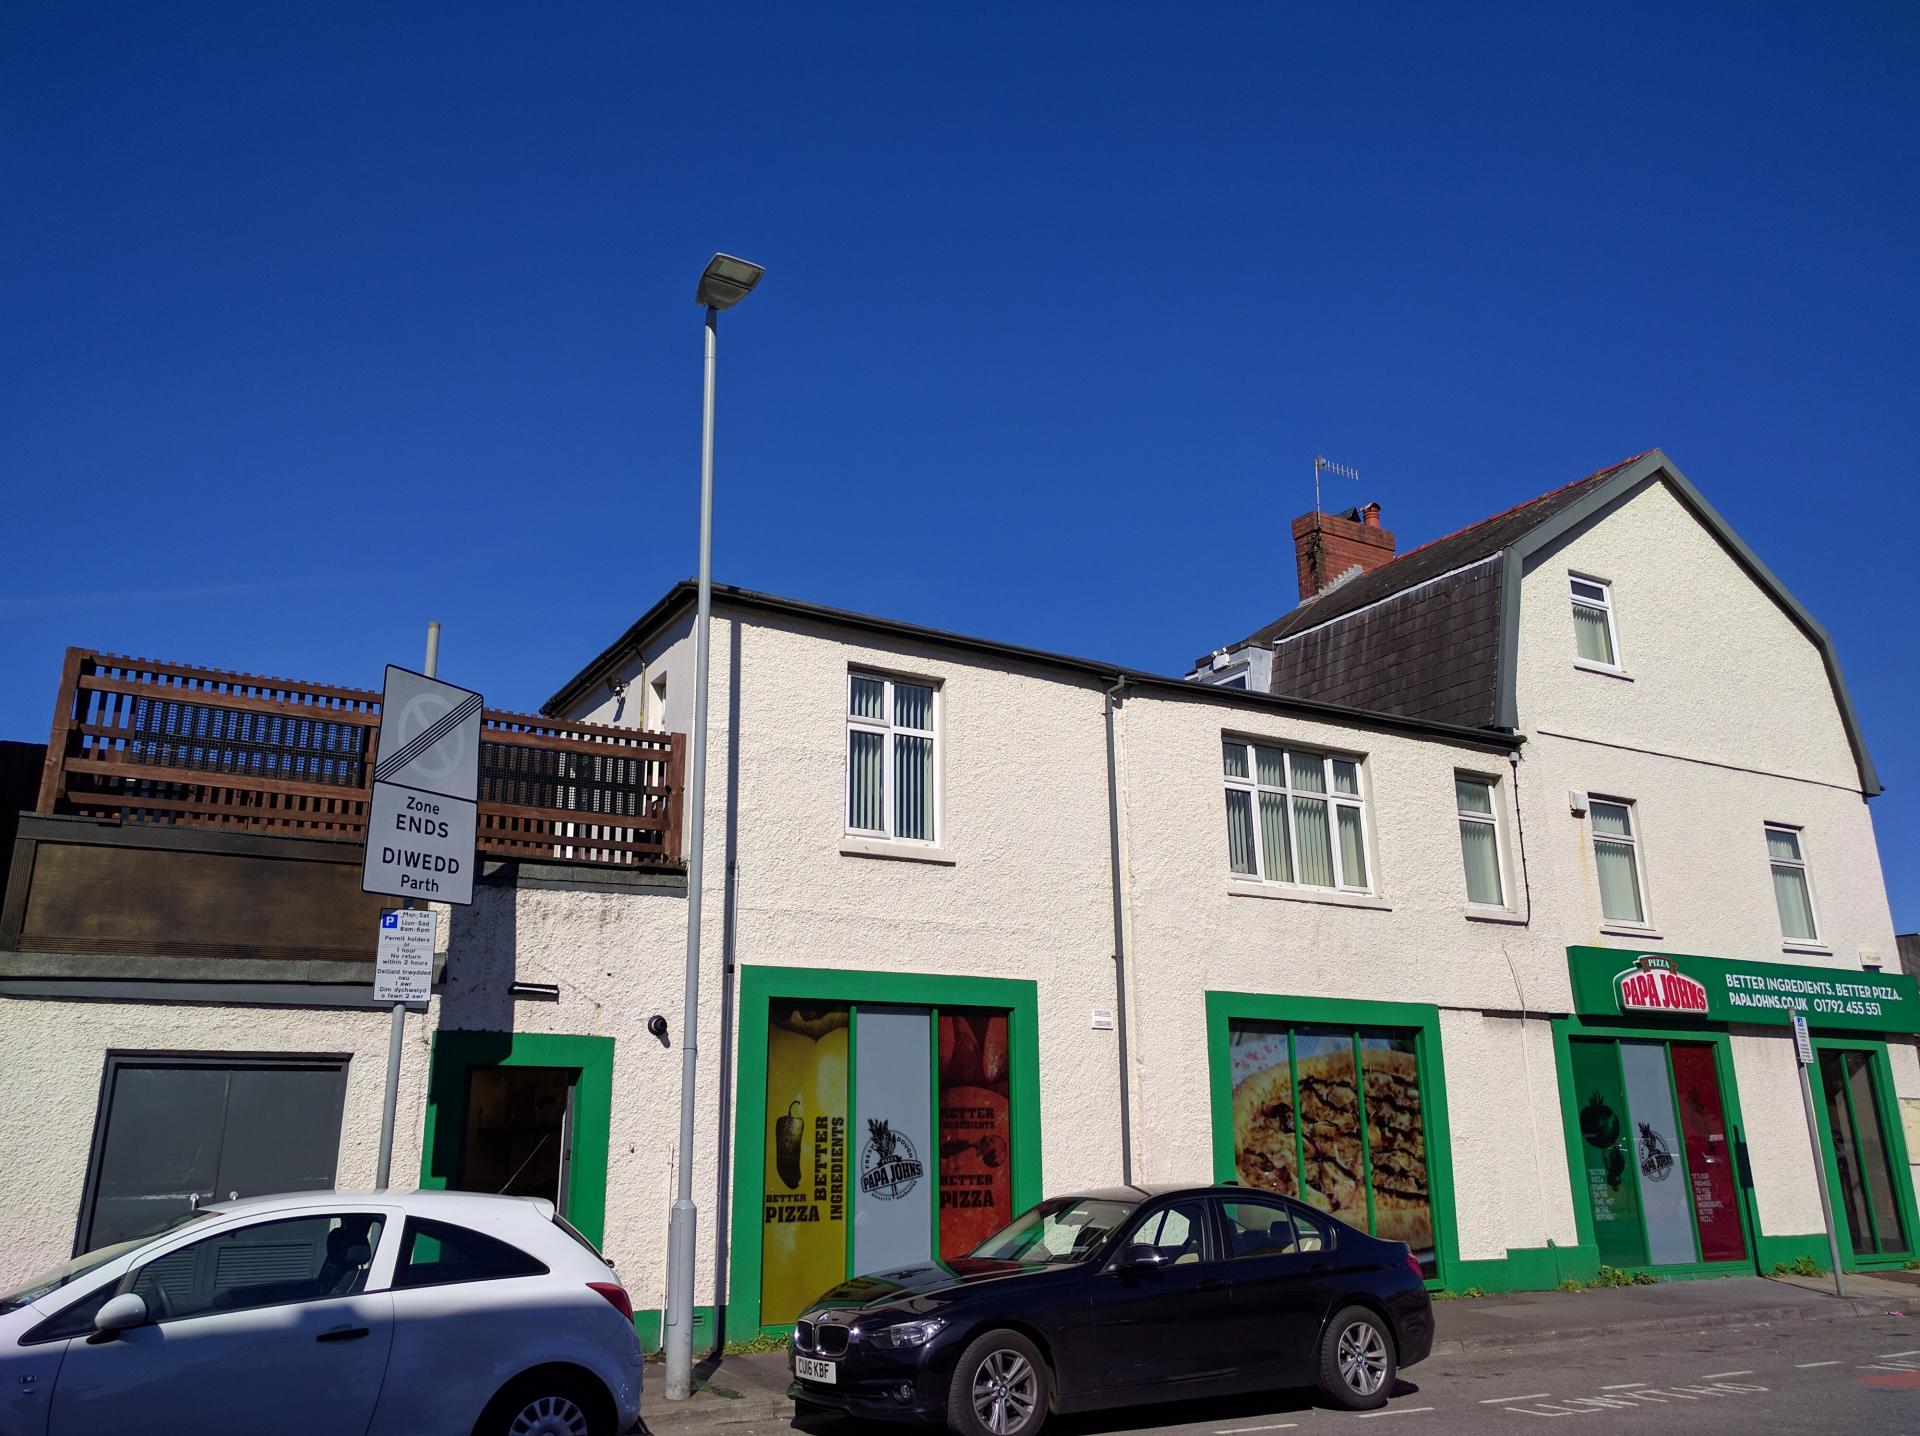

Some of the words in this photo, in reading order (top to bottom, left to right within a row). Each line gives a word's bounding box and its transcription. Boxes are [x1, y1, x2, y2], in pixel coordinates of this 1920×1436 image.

[406, 796, 440, 815] Zone
[396, 813, 449, 839] ENDS
[382, 847, 460, 875] DIWEDD
[400, 874, 439, 893] Parth
[1647, 958, 1670, 969] PIZZA
[1622, 973, 1662, 1007] PAPA
[1660, 974, 1707, 1010] JOHNS
[1725, 973, 1765, 990] BETTER
[1766, 977, 1836, 996] INGREDIENTS.
[1836, 983, 1876, 999] BETTER
[1872, 986, 1903, 1001] PIZZA.
[1728, 992, 1809, 1011] PAPAJOHNS.CO.UK
[1813, 1000, 1845, 1014] 01792
[1846, 1002, 1864, 1015] 455
[1865, 1002, 1882, 1016] 551
[940, 1107, 994, 1119] BETTER
[814, 1116, 828, 1201] BETTER
[865, 1143, 876, 1169] FRESH
[896, 1136, 913, 1159] DOUGH
[830, 1117, 844, 1221] INGREDIENTS
[863, 1167, 890, 1190] PAPA
[890, 1163, 922, 1182] JOHNS
[940, 1174, 993, 1186] BETTER
[766, 1194, 806, 1203] BETTER
[940, 1190, 995, 1209] PIZZA
[765, 1205, 820, 1223] PIZZA
[814, 1361, 829, 1379] KBF
